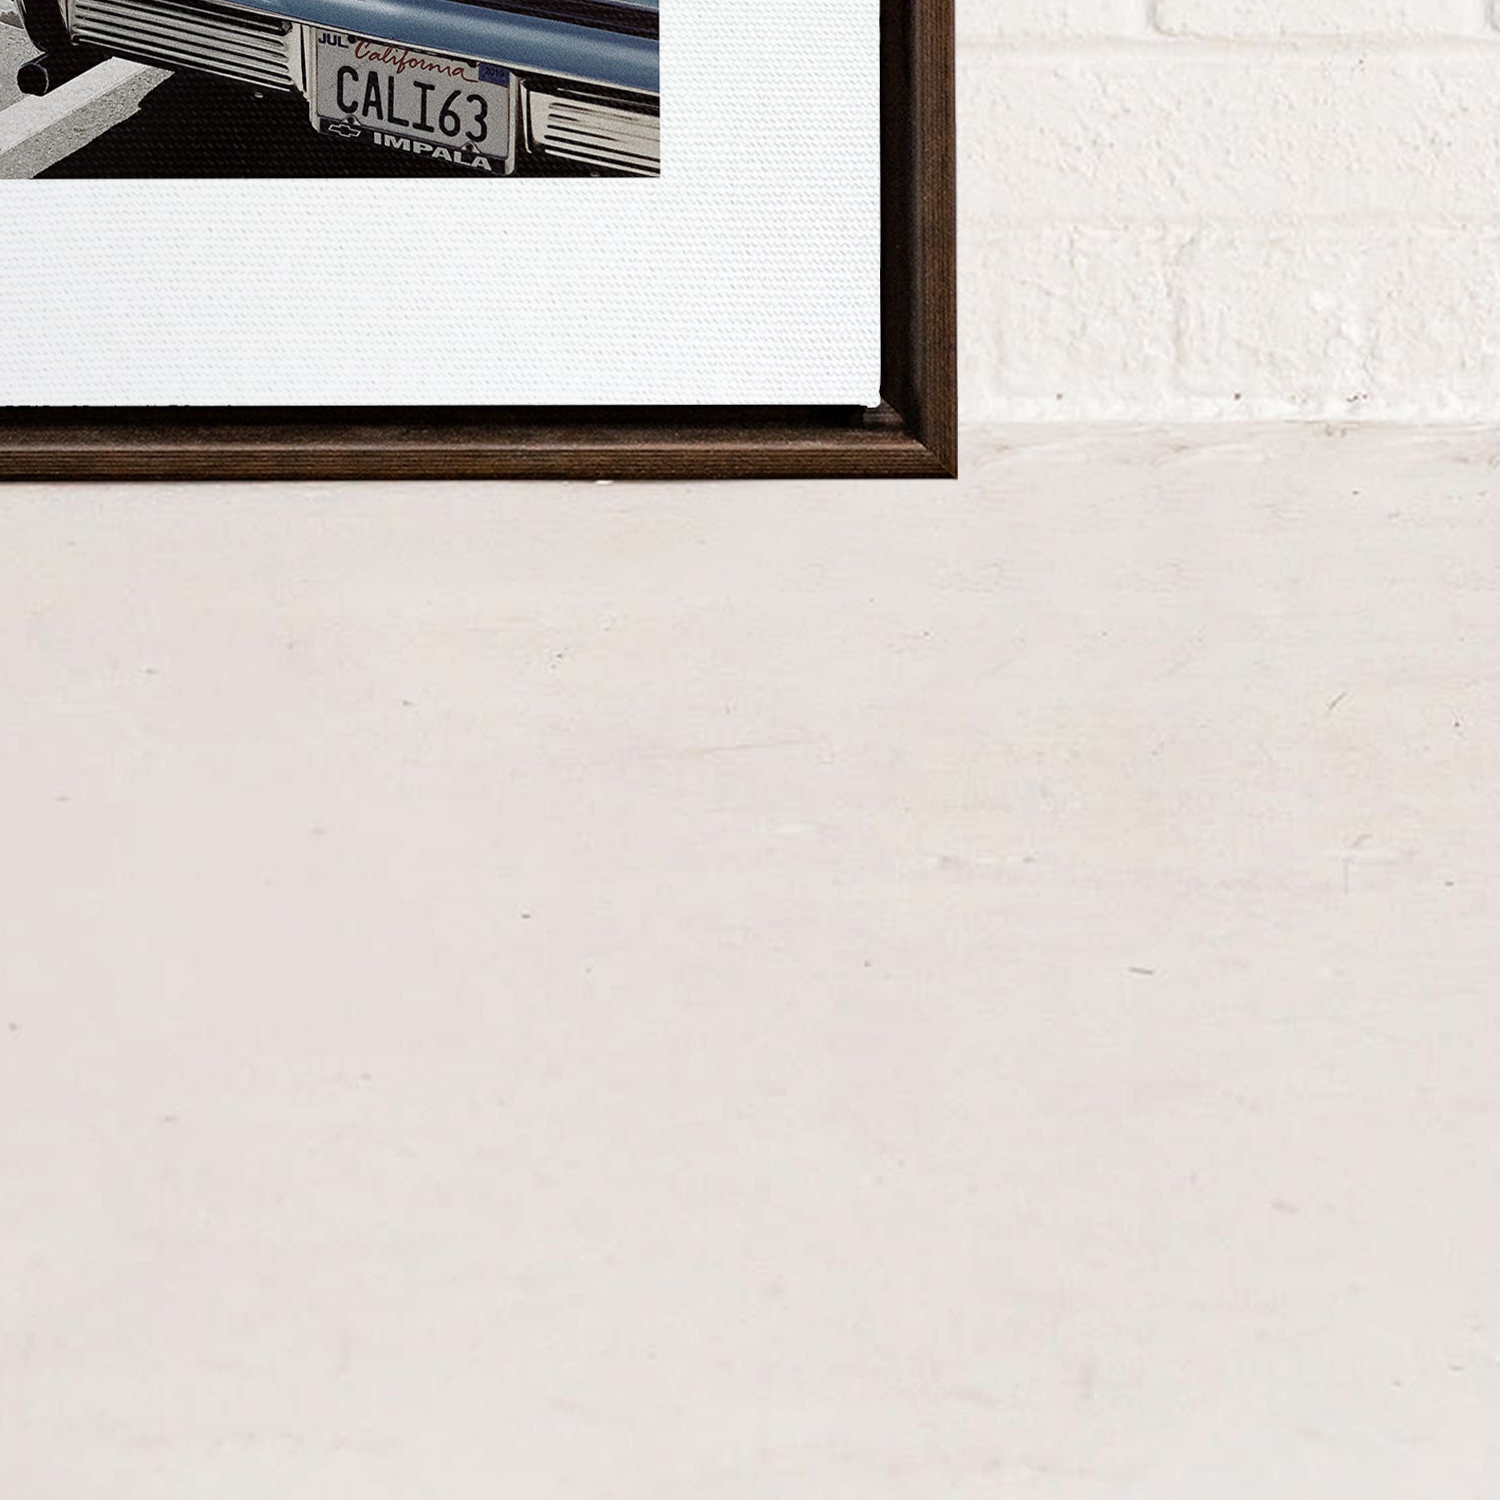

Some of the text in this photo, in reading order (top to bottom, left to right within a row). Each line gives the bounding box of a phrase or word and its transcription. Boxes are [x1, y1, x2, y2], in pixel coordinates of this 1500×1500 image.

[318, 32, 349, 49] JUL
[355, 40, 479, 83] California
[336, 65, 488, 143] CALI63
[373, 131, 493, 172] IMPALA
